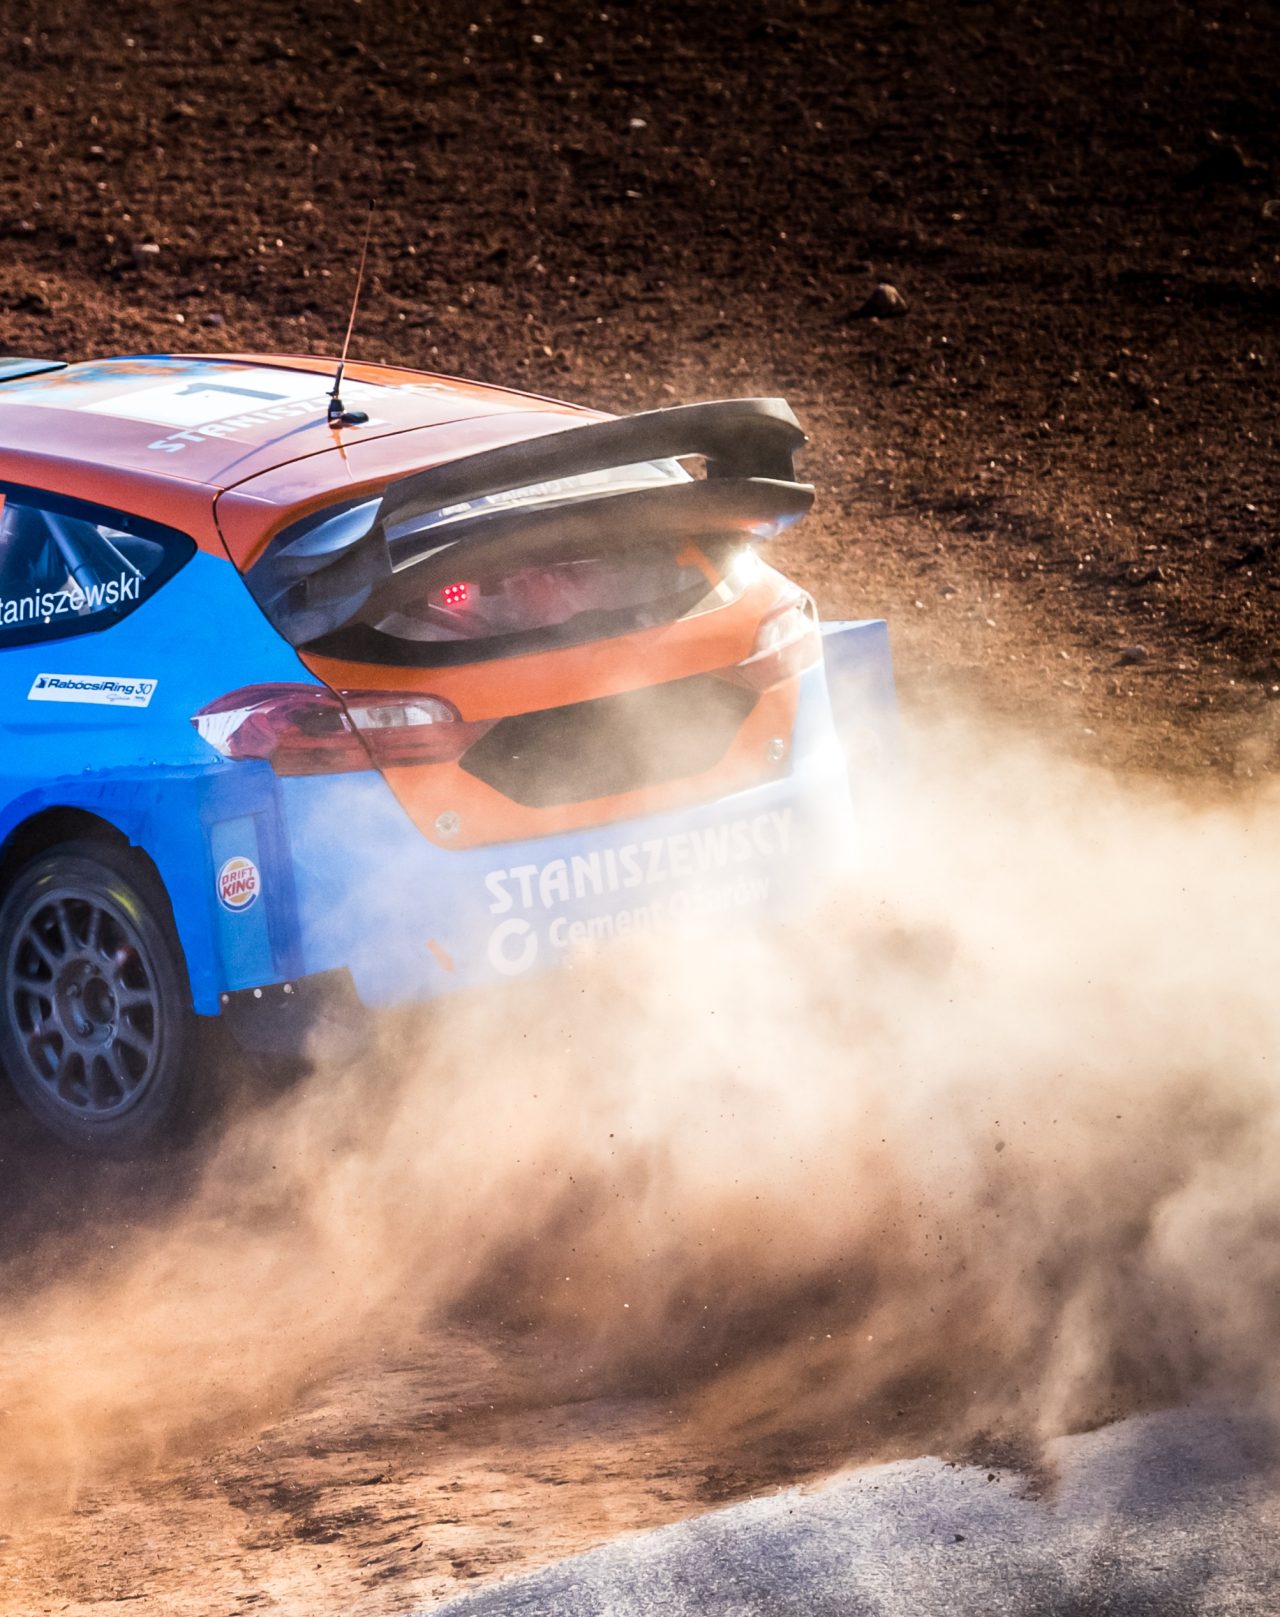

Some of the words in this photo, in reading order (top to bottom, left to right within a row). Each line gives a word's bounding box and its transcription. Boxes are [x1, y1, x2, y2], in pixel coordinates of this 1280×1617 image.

[135, 682, 153, 695] 30
[484, 808, 793, 915] STANISZEWSCY
[222, 866, 254, 885] DRIFT
[223, 877, 256, 899] KING
[548, 898, 663, 948] Cement
